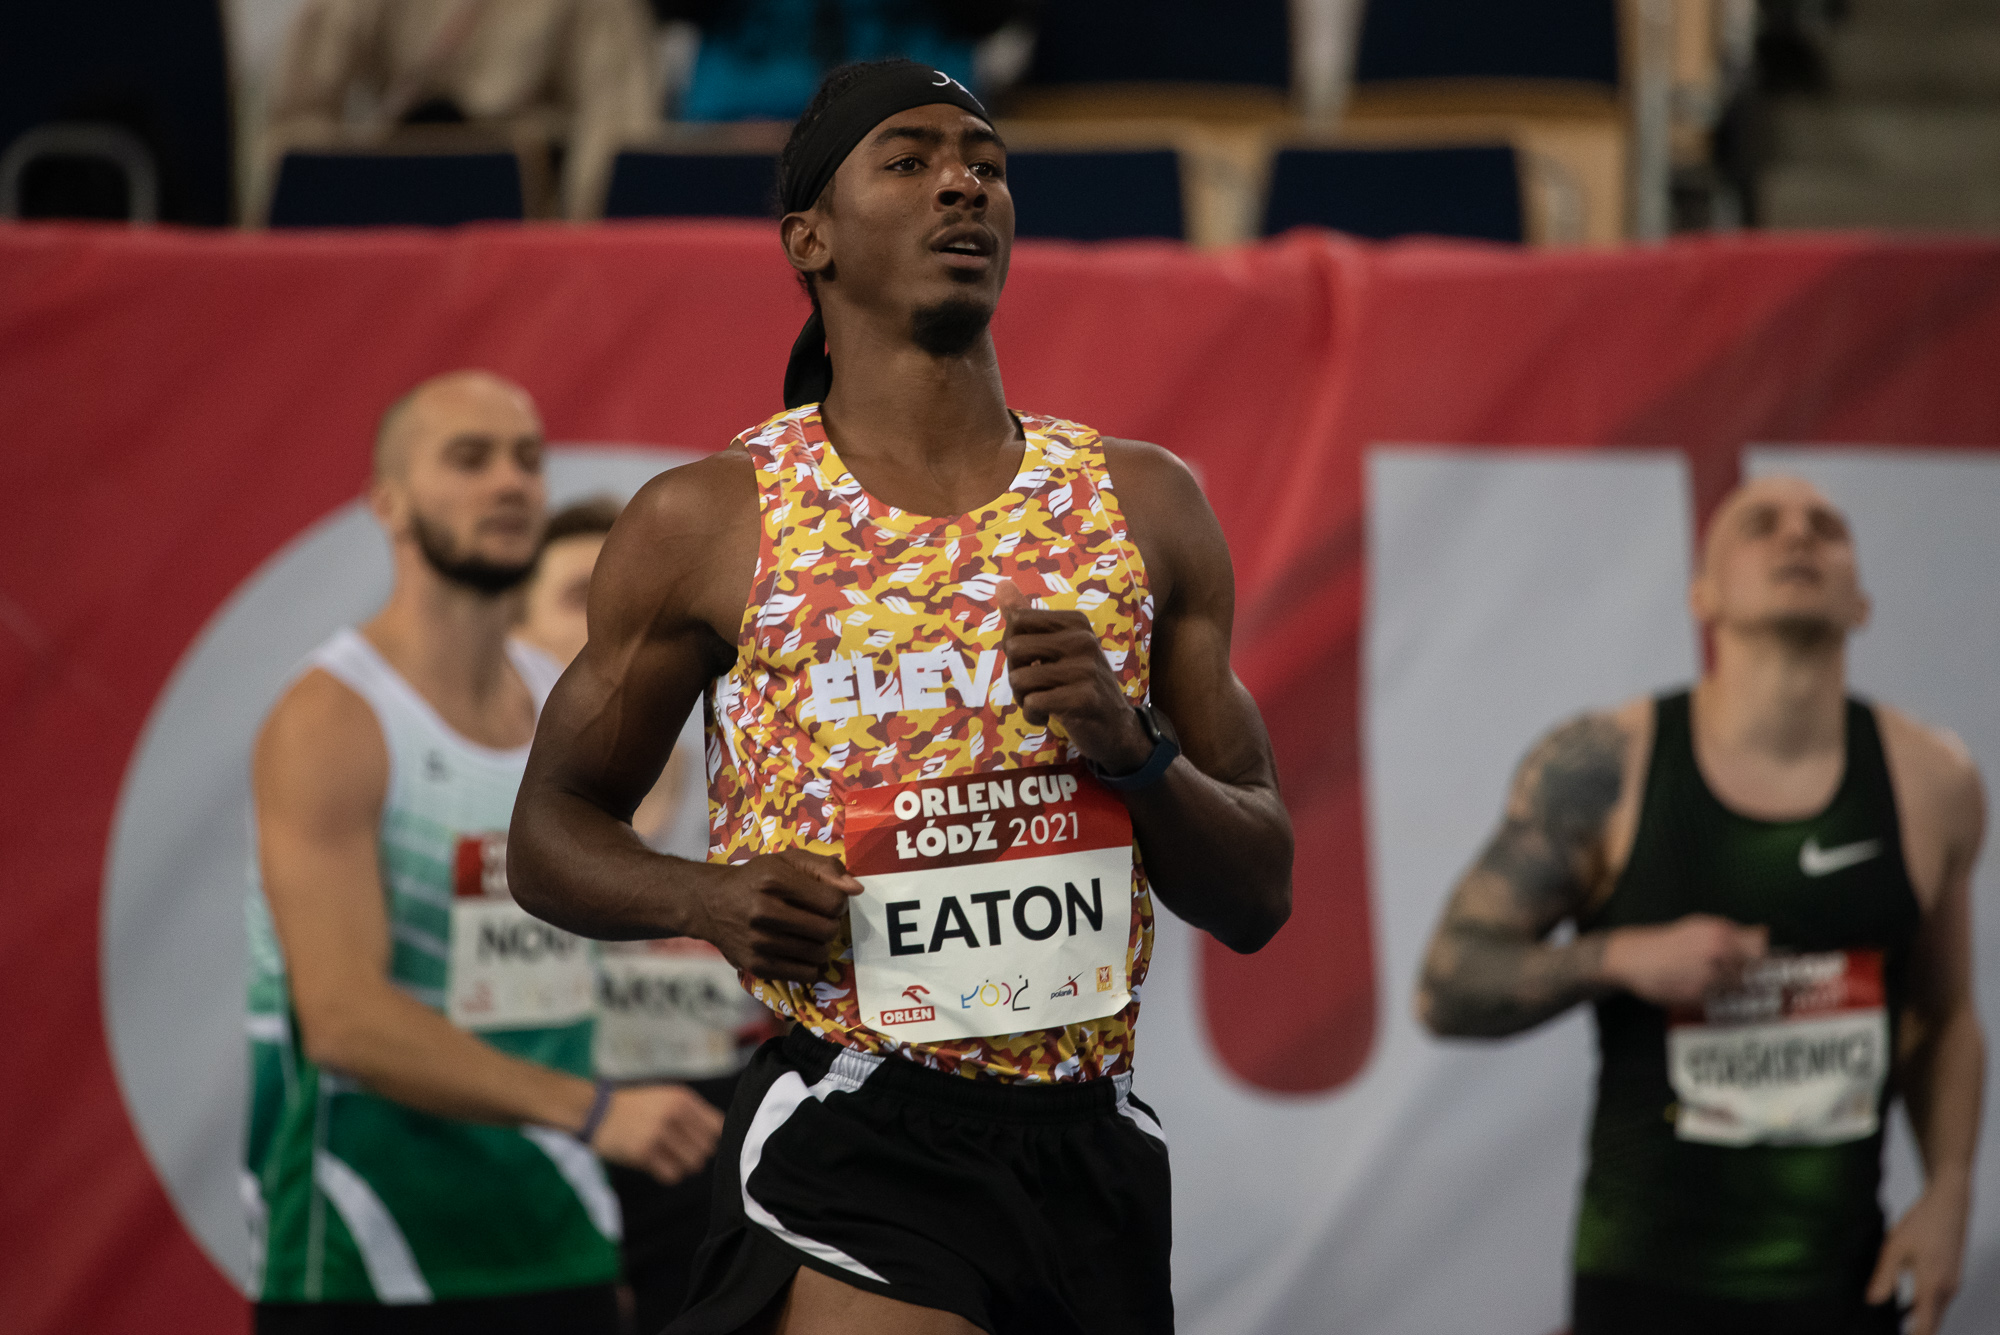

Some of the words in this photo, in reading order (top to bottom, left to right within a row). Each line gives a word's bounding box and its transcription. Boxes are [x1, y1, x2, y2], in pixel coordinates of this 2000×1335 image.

[809, 649, 1012, 723] ELEV
[893, 779, 1014, 821] ORLEN
[1017, 773, 1079, 806] CUP
[895, 813, 999, 860] ŁÓDŹ
[1008, 811, 1080, 848] 2021
[885, 877, 1104, 957] EATON
[883, 1008, 932, 1024] ORLEN
